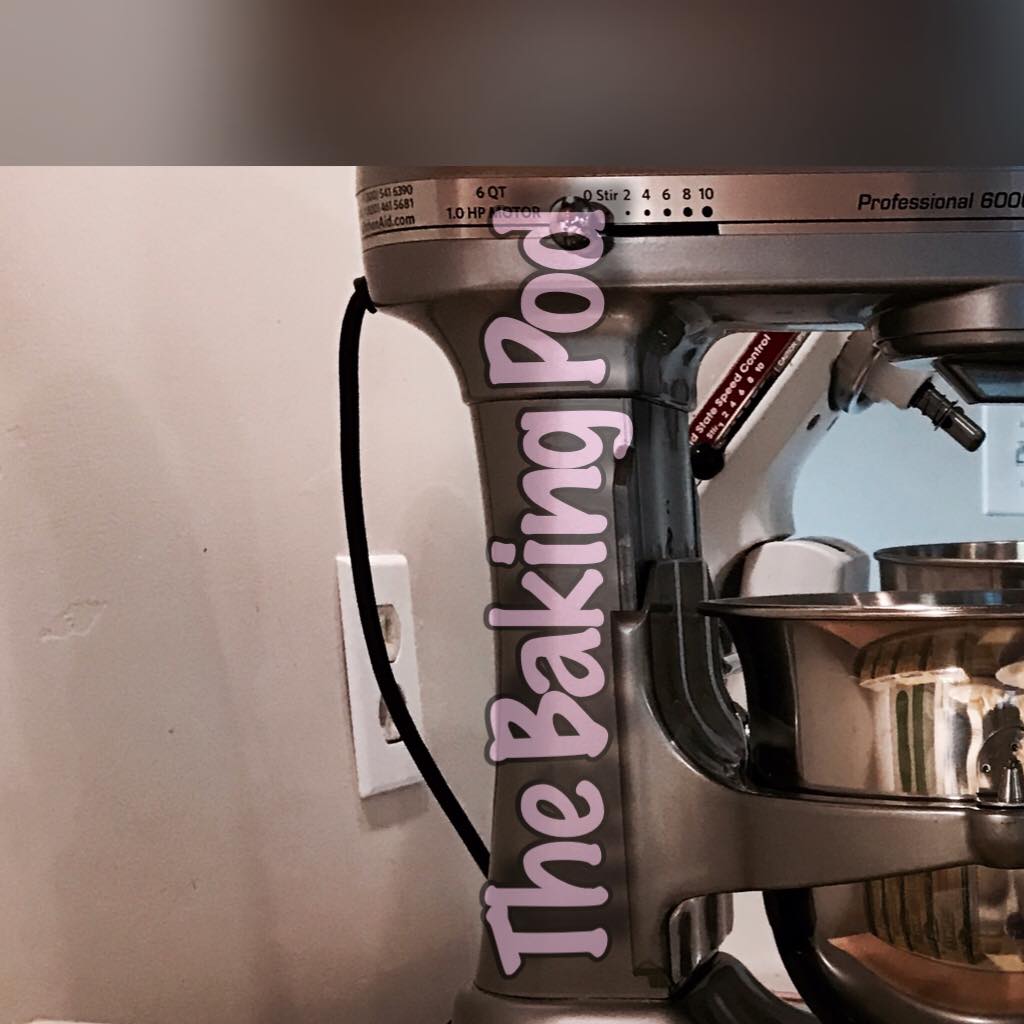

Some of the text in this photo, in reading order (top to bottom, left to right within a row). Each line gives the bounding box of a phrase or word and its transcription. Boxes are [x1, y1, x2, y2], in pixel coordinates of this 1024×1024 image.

[476, 186, 507, 201] 6 QT
[596, 188, 619, 202] Stir
[622, 189, 631, 201] 2
[641, 188, 651, 201] 4
[661, 188, 671, 201] 6
[682, 188, 692, 200] 8
[699, 187, 714, 200] 10
[857, 191, 974, 211] Professional
[447, 206, 541, 220] 1.0 HP MOTOR
[695, 407, 718, 434] State
[715, 373, 742, 407] Speed
[739, 333, 772, 374] Control
